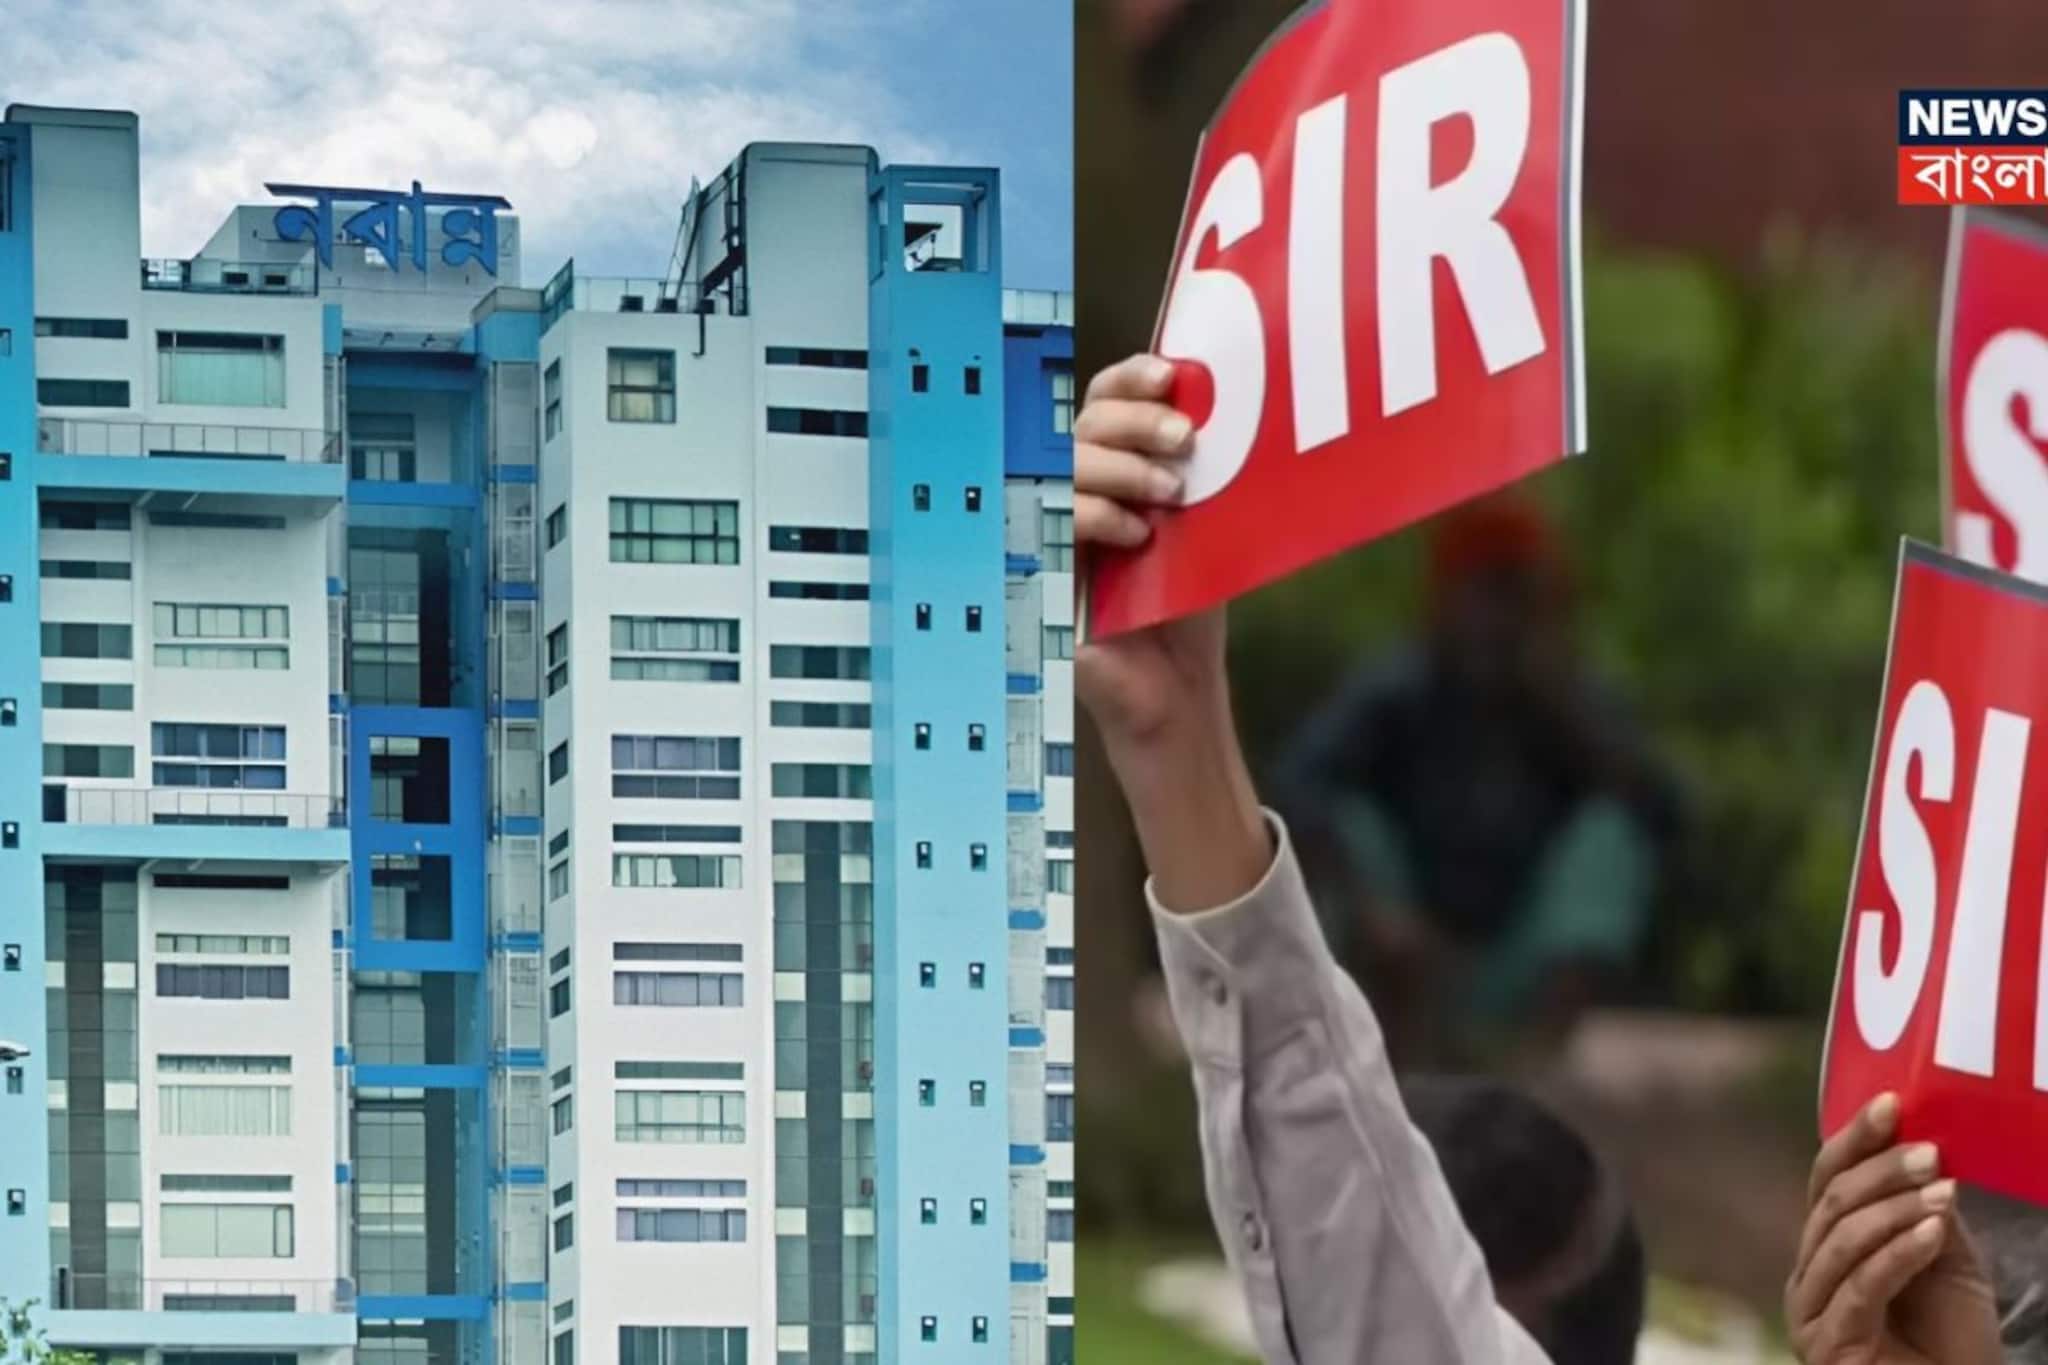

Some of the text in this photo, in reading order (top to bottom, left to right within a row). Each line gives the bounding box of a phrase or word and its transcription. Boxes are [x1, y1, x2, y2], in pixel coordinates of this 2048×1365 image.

[264, 180, 512, 278] নবান্ন
[1161, 31, 1546, 507] SIR
[1853, 680, 2048, 1093] SI
